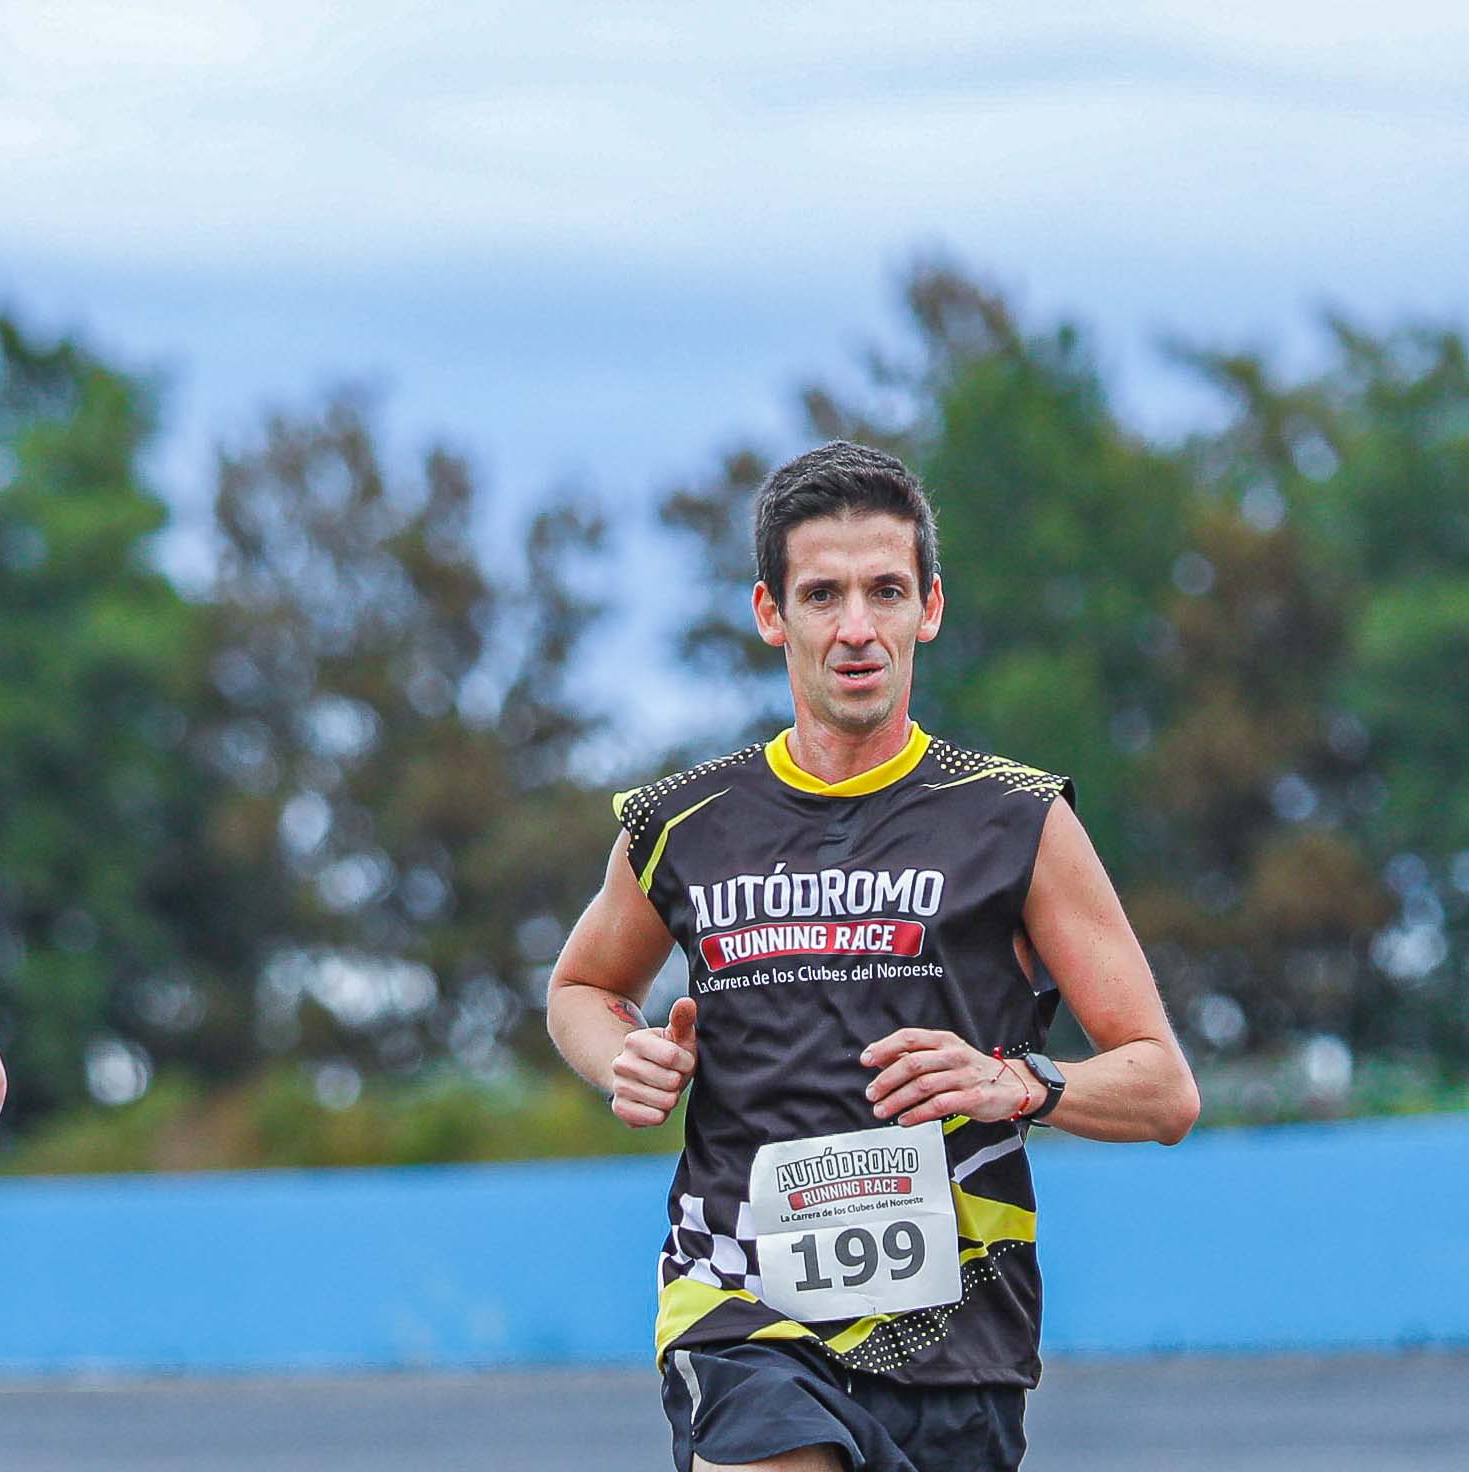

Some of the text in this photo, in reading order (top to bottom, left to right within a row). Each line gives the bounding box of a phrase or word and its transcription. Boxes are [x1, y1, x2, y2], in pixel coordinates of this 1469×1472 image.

[688, 862, 946, 933] AUTÓDROMO
[718, 924, 896, 963] RUNNING RACE
[696, 962, 943, 994] La Carrera de los Clubes del Noroeste
[776, 1147, 919, 1193] AUTÓDROMO
[780, 1196, 924, 1223] La Carrera de los Clubes del Noroeste
[802, 1178, 899, 1206] RUNNING RACE
[790, 1220, 926, 1292] 199
